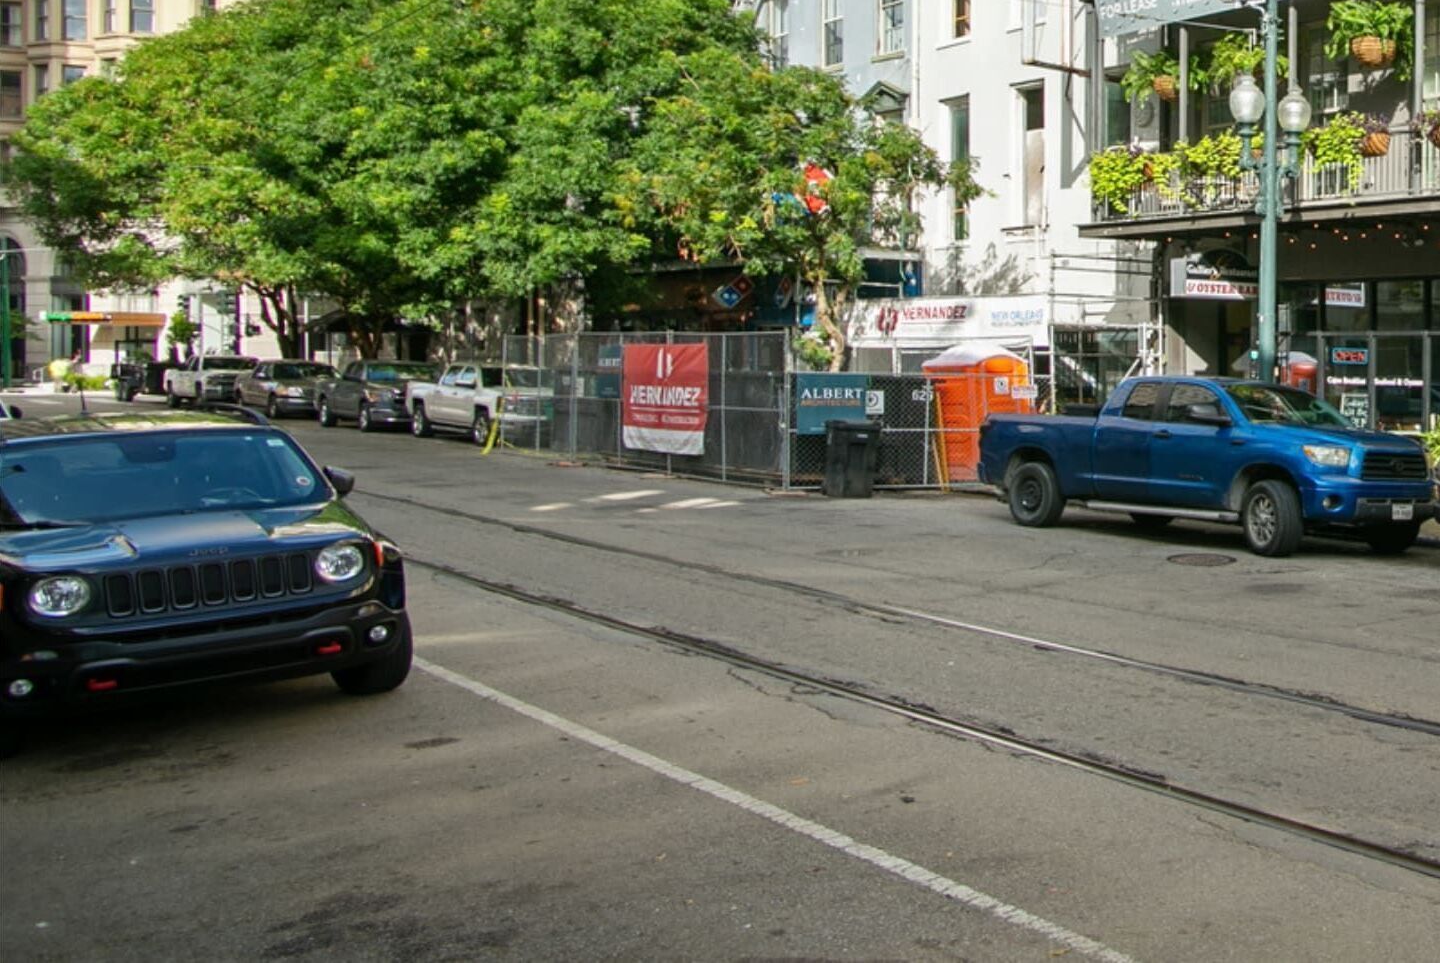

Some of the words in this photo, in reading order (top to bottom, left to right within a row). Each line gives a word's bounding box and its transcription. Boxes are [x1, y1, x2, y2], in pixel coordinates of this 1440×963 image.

[1100, 4, 1122, 19] FOR
[1197, 284, 1238, 294] OYSTER
[902, 305, 967, 320] HERNANDEZ
[1335, 351, 1365, 362] OPEN
[630, 385, 702, 407] HERNANDEZ
[800, 387, 864, 399] ALBERT
[188, 545, 229, 557] Jeep
